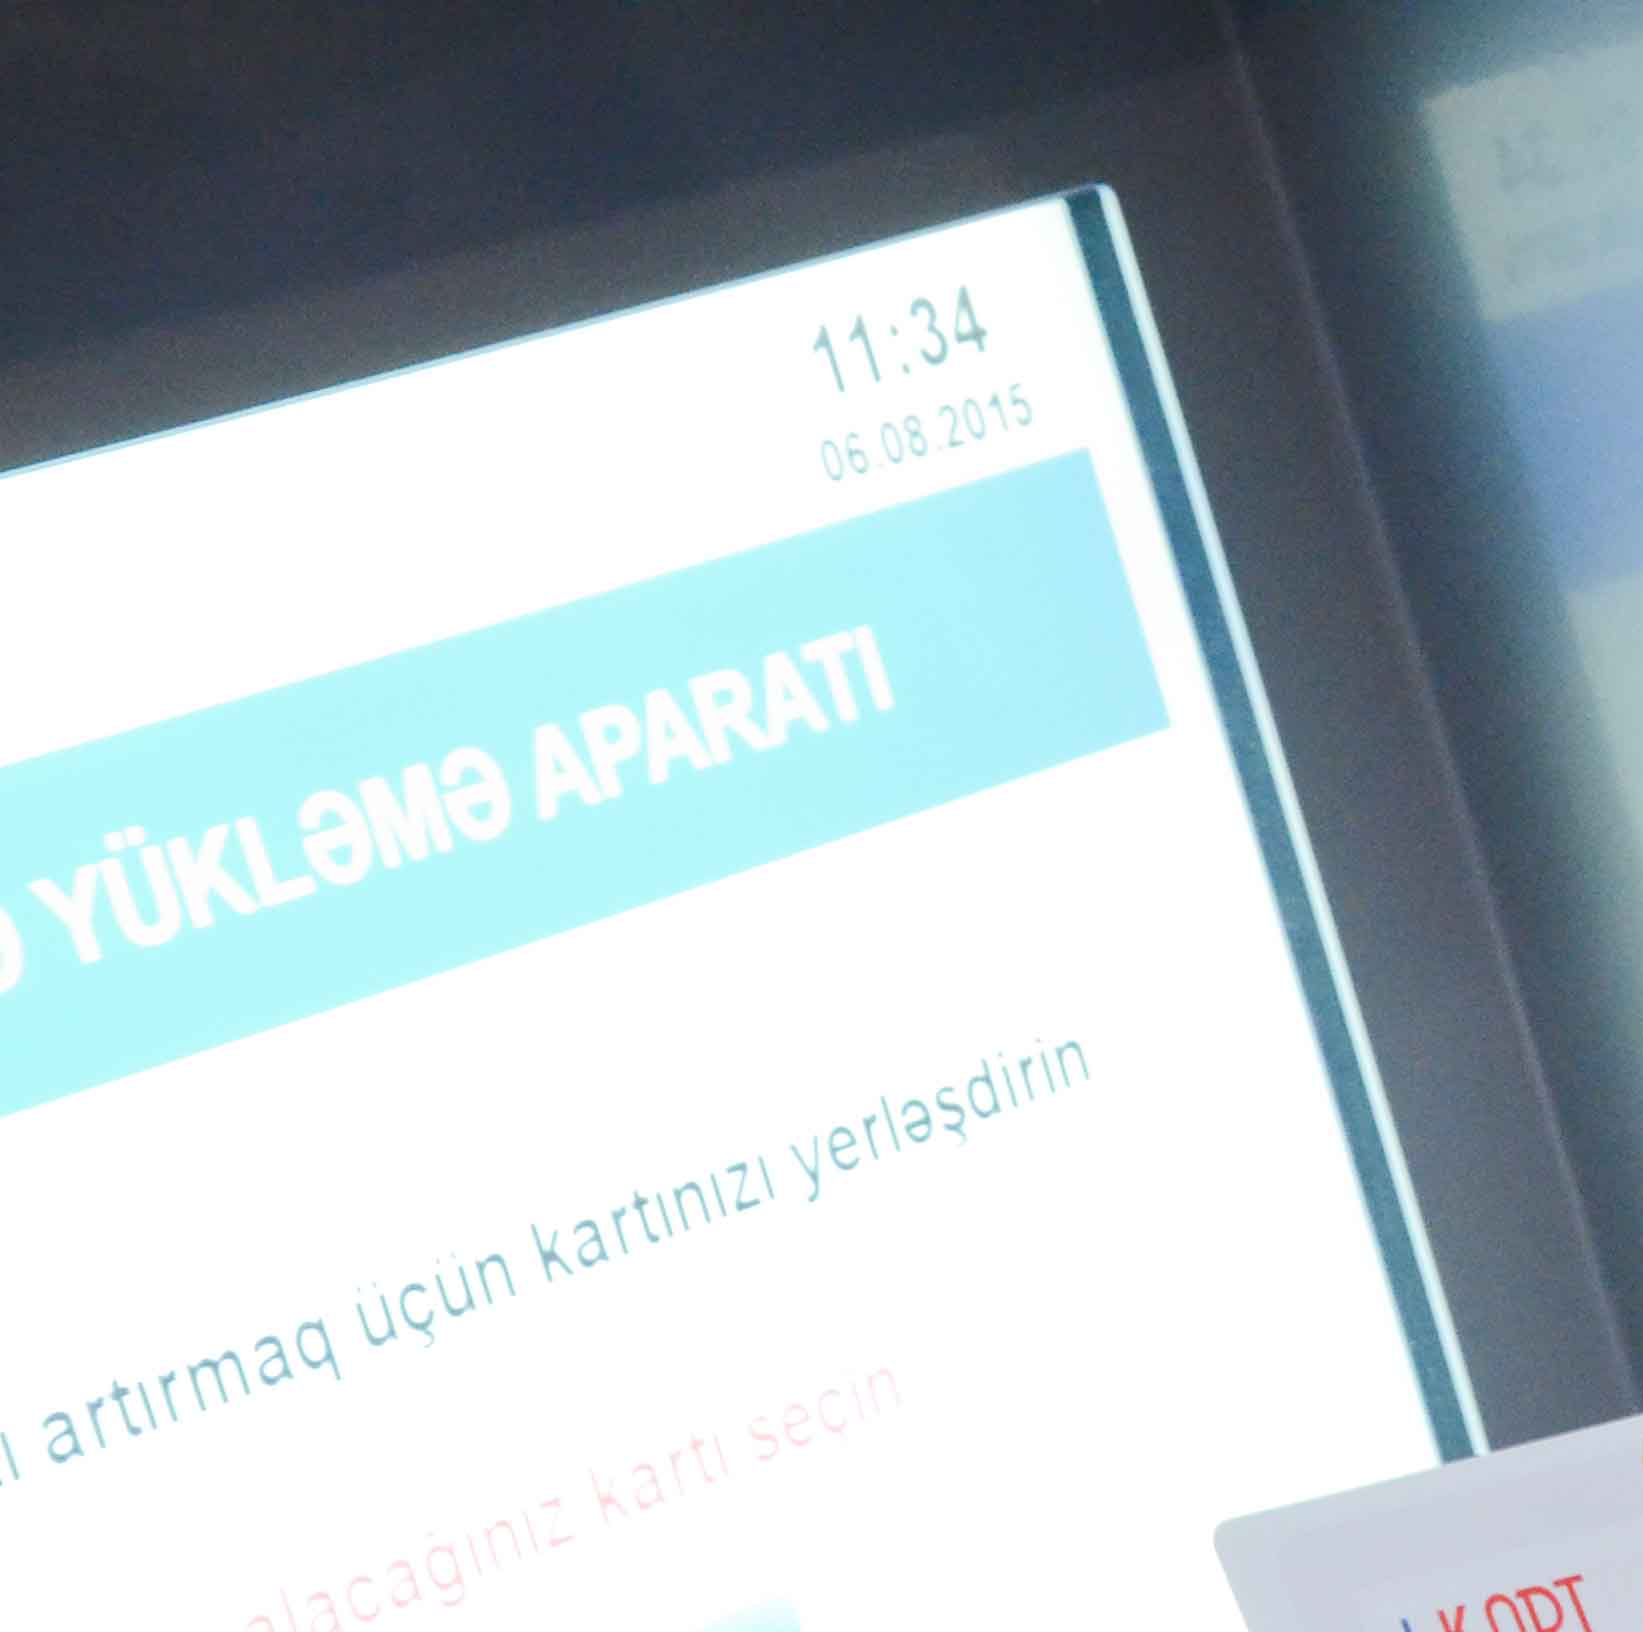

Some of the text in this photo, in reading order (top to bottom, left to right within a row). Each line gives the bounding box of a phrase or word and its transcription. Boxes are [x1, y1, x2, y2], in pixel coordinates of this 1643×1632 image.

[814, 284, 988, 393] 11:34
[820, 383, 1033, 482] 06.08.2015
[28, 746, 511, 964] YÜKLƏMƏ
[533, 625, 894, 820] APARATI
[42, 1317, 341, 1463] artırmaq
[355, 1249, 517, 1348] üçün
[530, 1155, 775, 1283] kartınızı
[789, 1037, 1090, 1203] yerləşdirin
[588, 1431, 730, 1527] kartı
[748, 1361, 904, 1465] seçin
